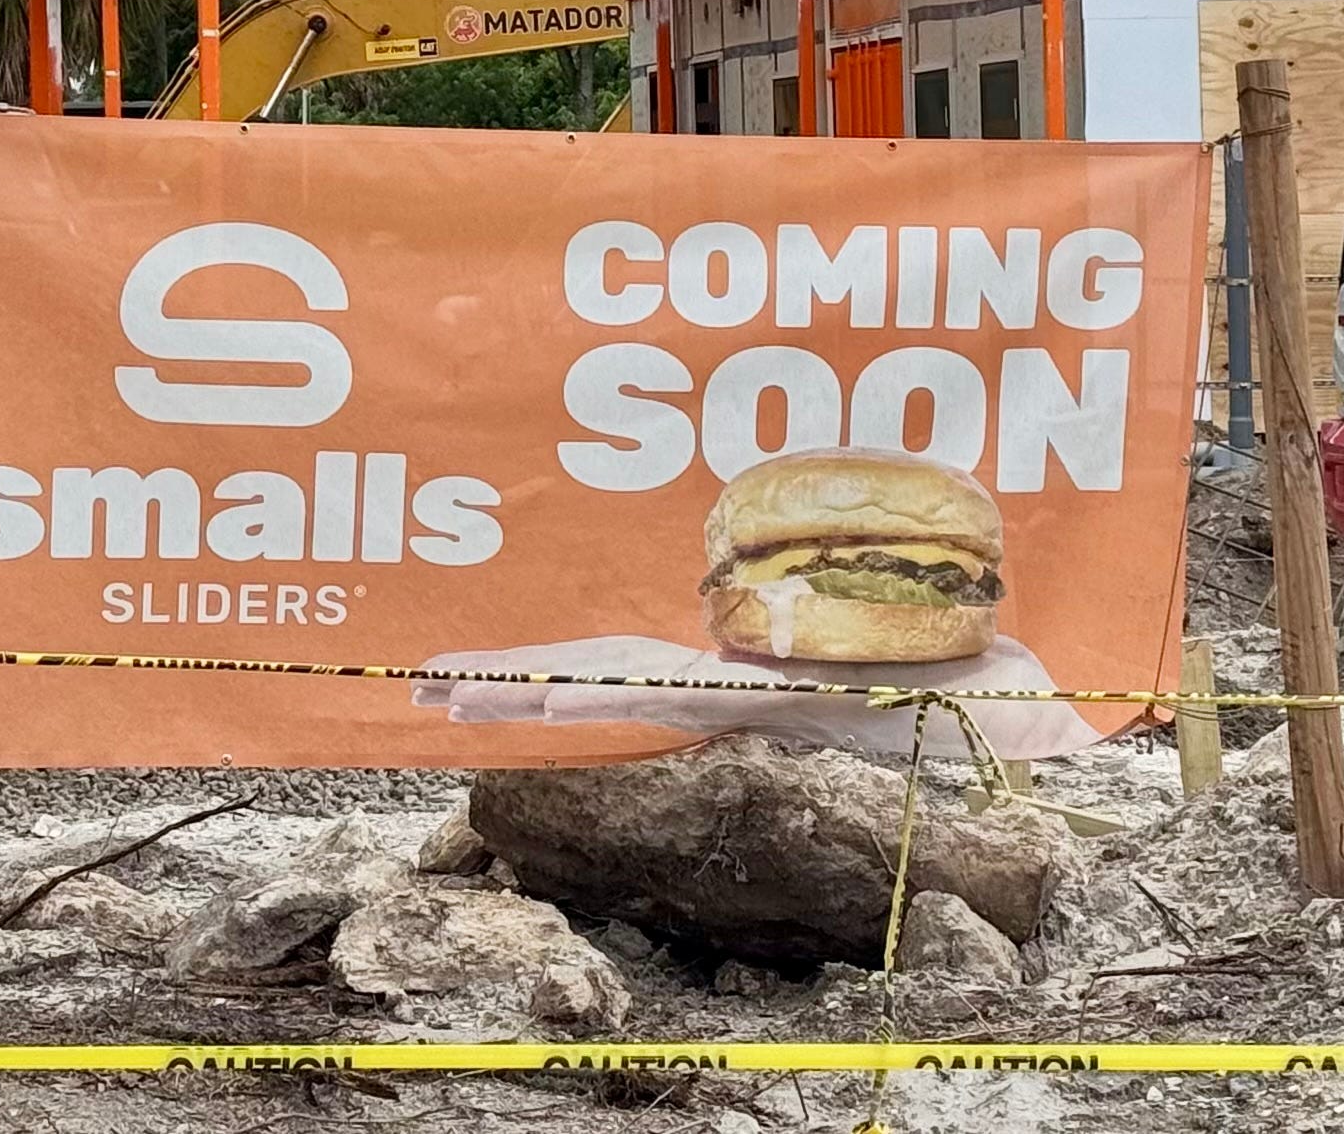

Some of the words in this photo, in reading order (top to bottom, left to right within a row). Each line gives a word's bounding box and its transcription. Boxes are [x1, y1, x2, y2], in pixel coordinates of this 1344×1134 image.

[484, 5, 624, 35] MATADOR
[563, 220, 1145, 331] COMING
[556, 342, 1131, 493] SOON
[101, 581, 349, 626] SLIDERS
